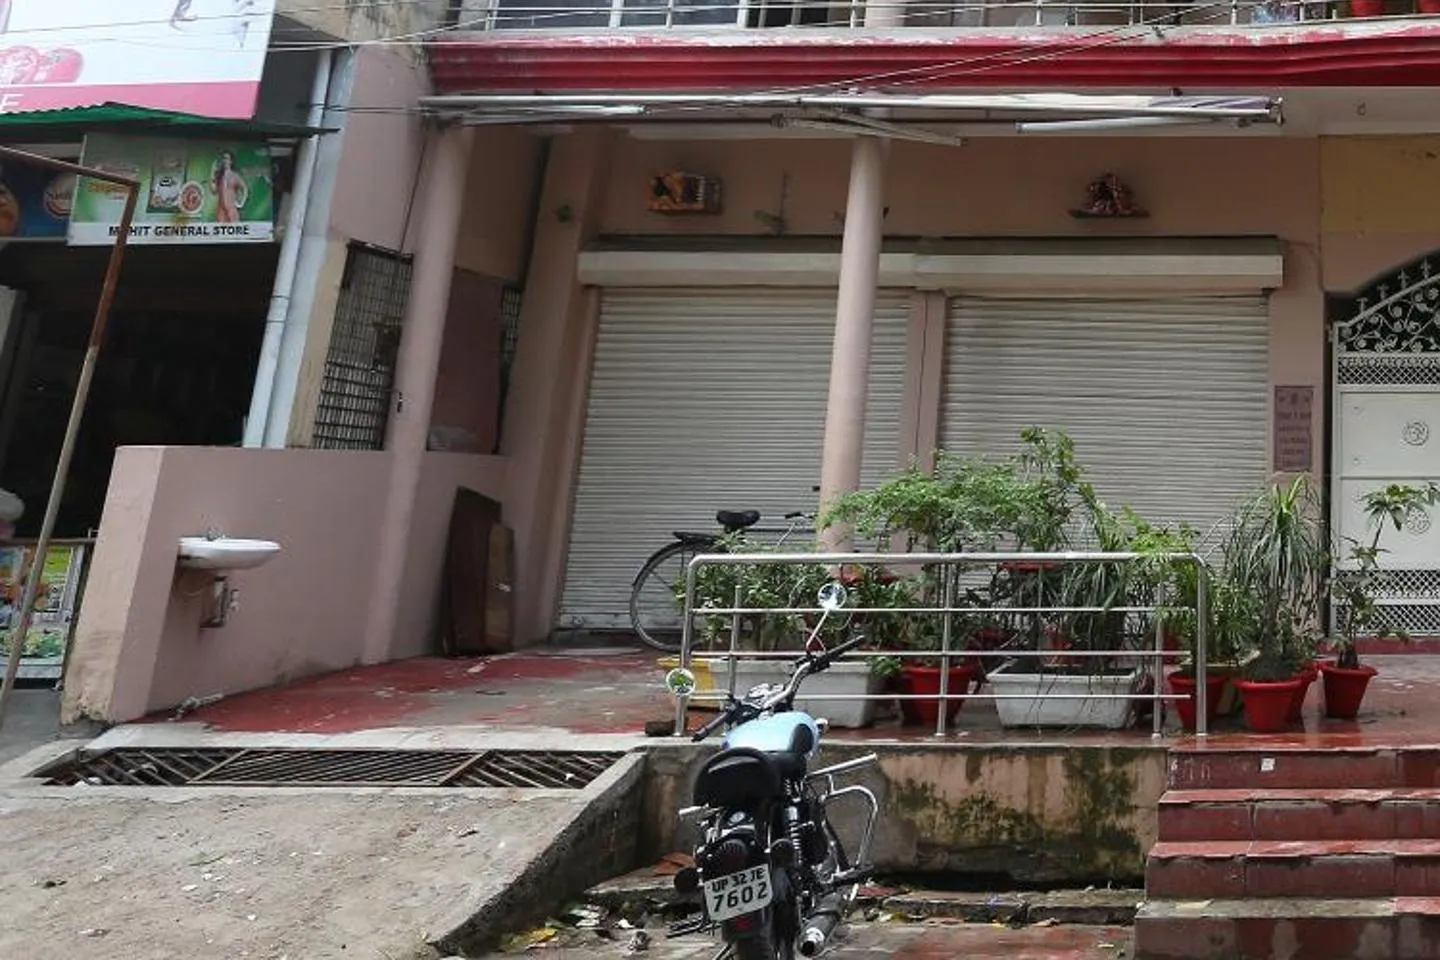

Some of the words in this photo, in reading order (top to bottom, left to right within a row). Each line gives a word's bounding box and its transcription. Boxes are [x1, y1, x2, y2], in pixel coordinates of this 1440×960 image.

[109, 225, 151, 237] MHIT
[154, 225, 209, 237] GENERAL
[213, 225, 250, 236] STORE
[712, 878, 728, 892] UP
[731, 873, 746, 887] 32
[713, 882, 767, 912] 7602
